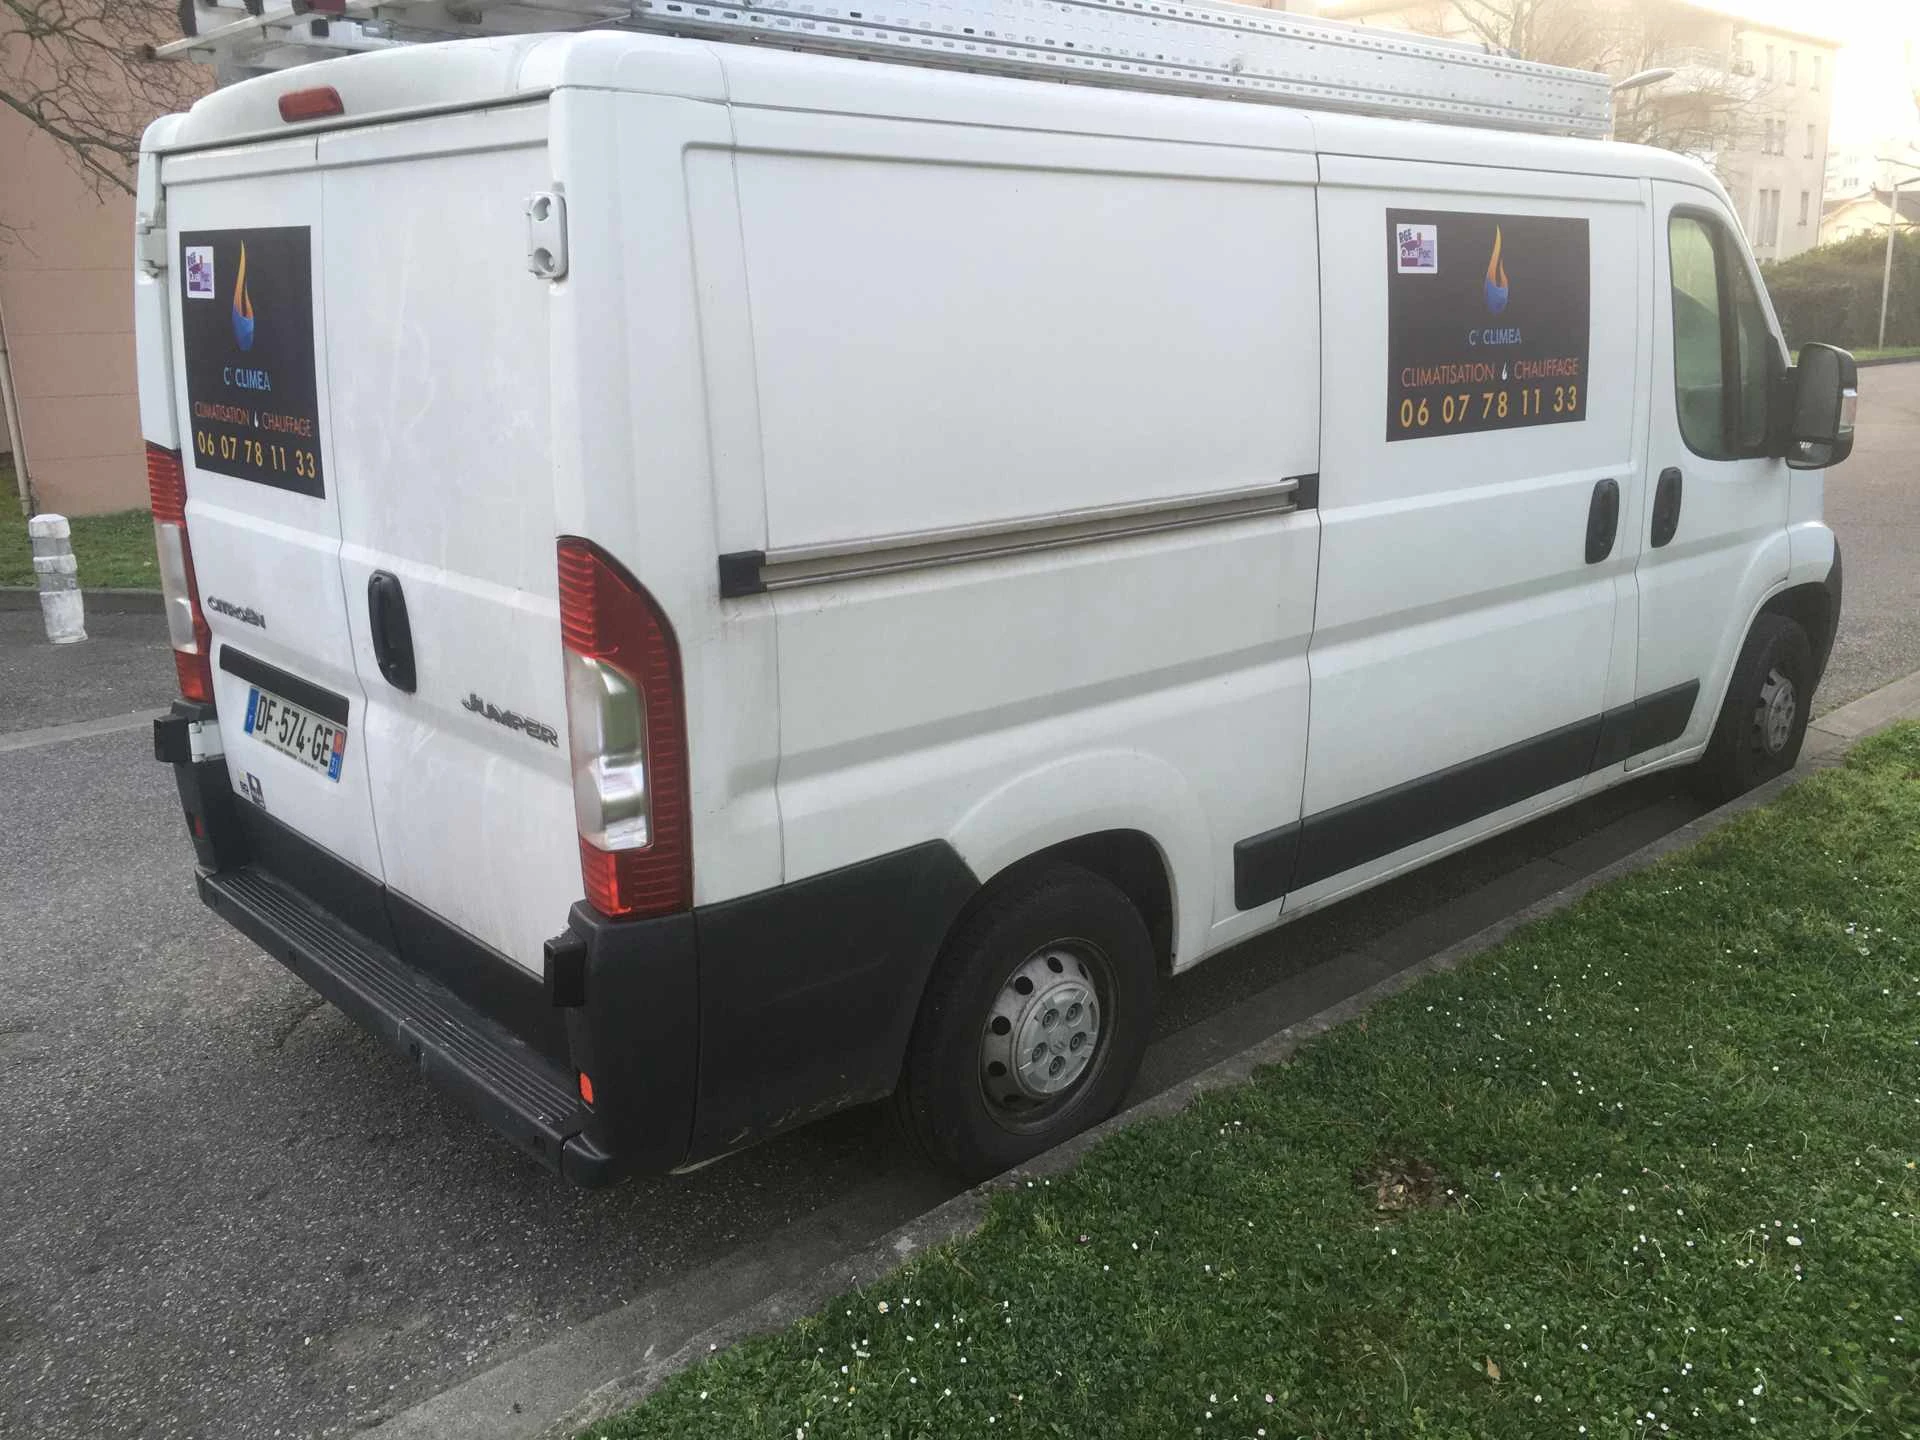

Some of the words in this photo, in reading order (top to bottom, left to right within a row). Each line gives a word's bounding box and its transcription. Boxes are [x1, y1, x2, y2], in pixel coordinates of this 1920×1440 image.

[1398, 228, 1413, 244] RGE
[1483, 327, 1522, 345] CLIMEA
[235, 368, 271, 392] CLIMEA
[1401, 362, 1495, 387] CLIMATISATION
[1514, 357, 1580, 380] CHAUFFAGE
[194, 400, 250, 426] CLIMATISATION
[262, 411, 312, 438] CHAUFFAGE
[1400, 397, 1429, 428] 06
[1442, 394, 1471, 424] 07
[1482, 391, 1508, 419] 78
[1522, 388, 1541, 416] 11
[1553, 385, 1577, 414] 33
[197, 430, 215, 457] 06
[220, 435, 238, 461] 07
[244, 439, 263, 467] 78
[270, 444, 287, 472] 11
[295, 450, 316, 479] 33
[461, 692, 559, 748] JUMPER
